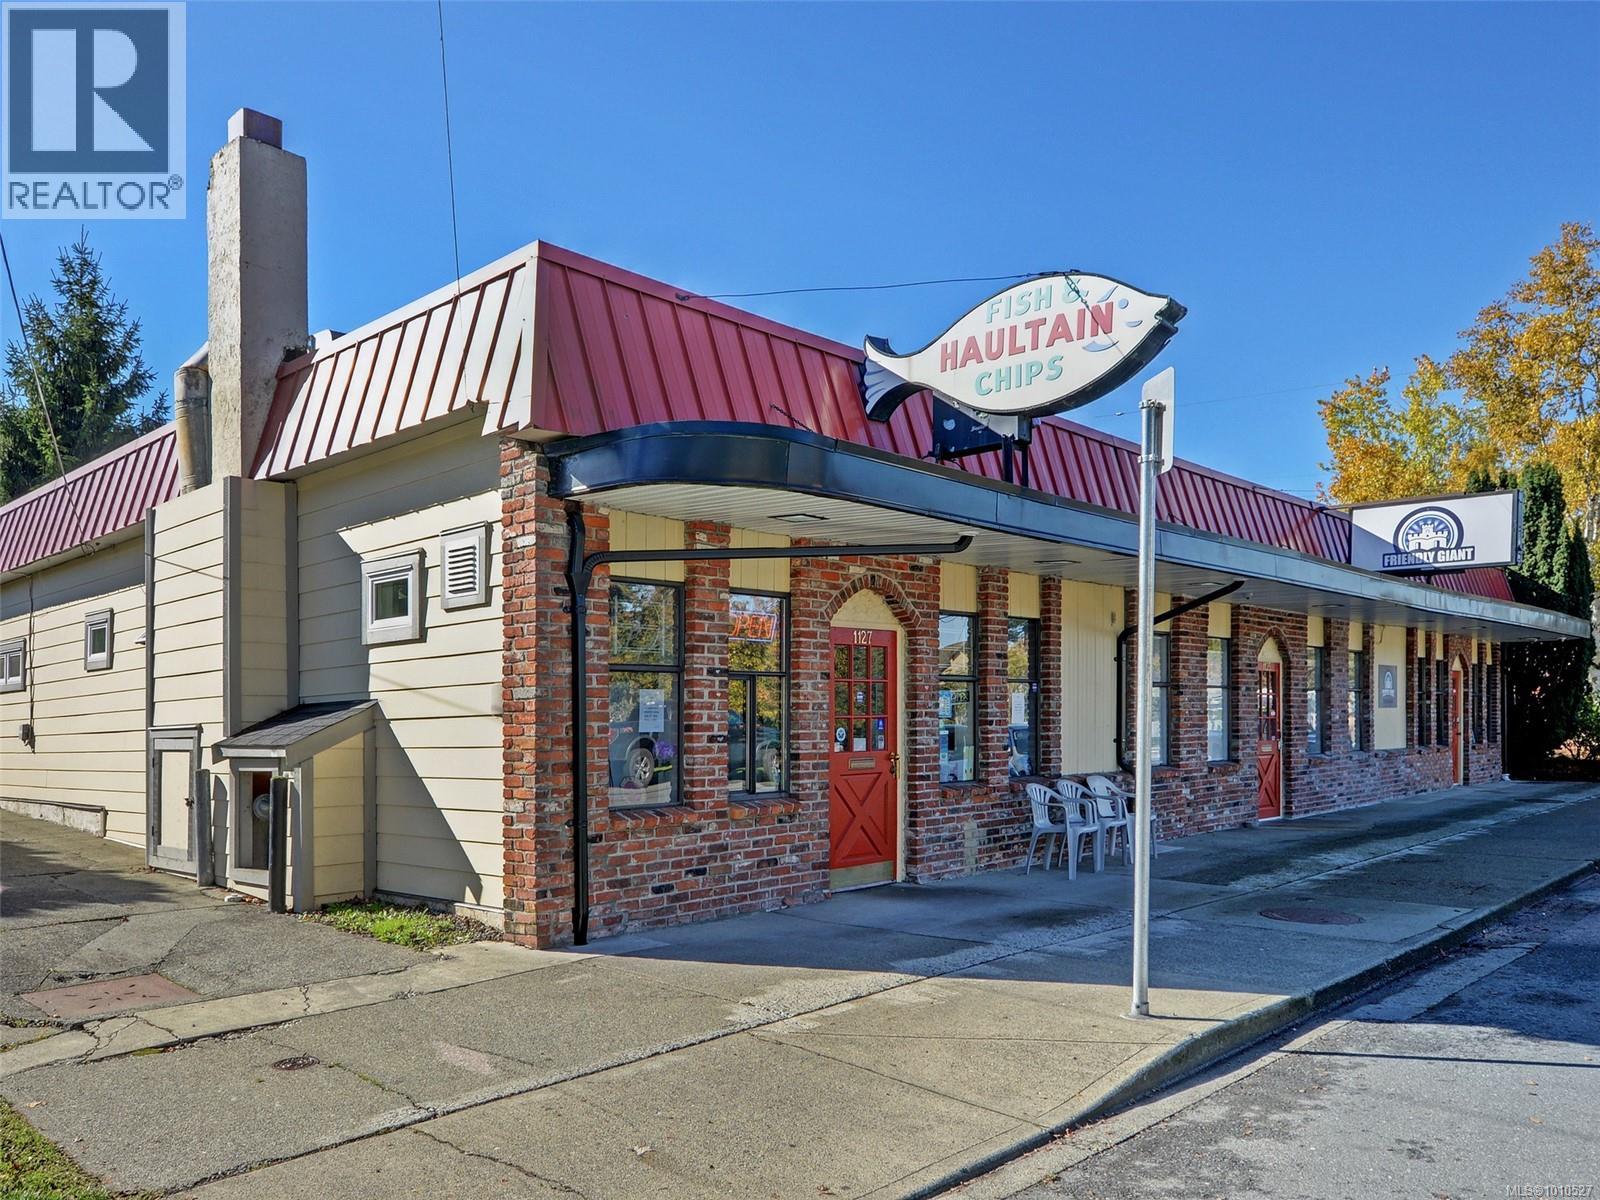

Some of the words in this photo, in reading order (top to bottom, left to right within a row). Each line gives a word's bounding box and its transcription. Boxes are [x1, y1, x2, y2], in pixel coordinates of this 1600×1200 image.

[986, 285, 1052, 324] FISH
[1062, 274, 1090, 304] &
[939, 301, 1114, 373] HAULTAIN
[974, 354, 1064, 396] CHIPS
[1383, 550, 1435, 567] FRIENDLY
[1437, 547, 1474, 562] GIANT
[853, 630, 872, 644] 1127
